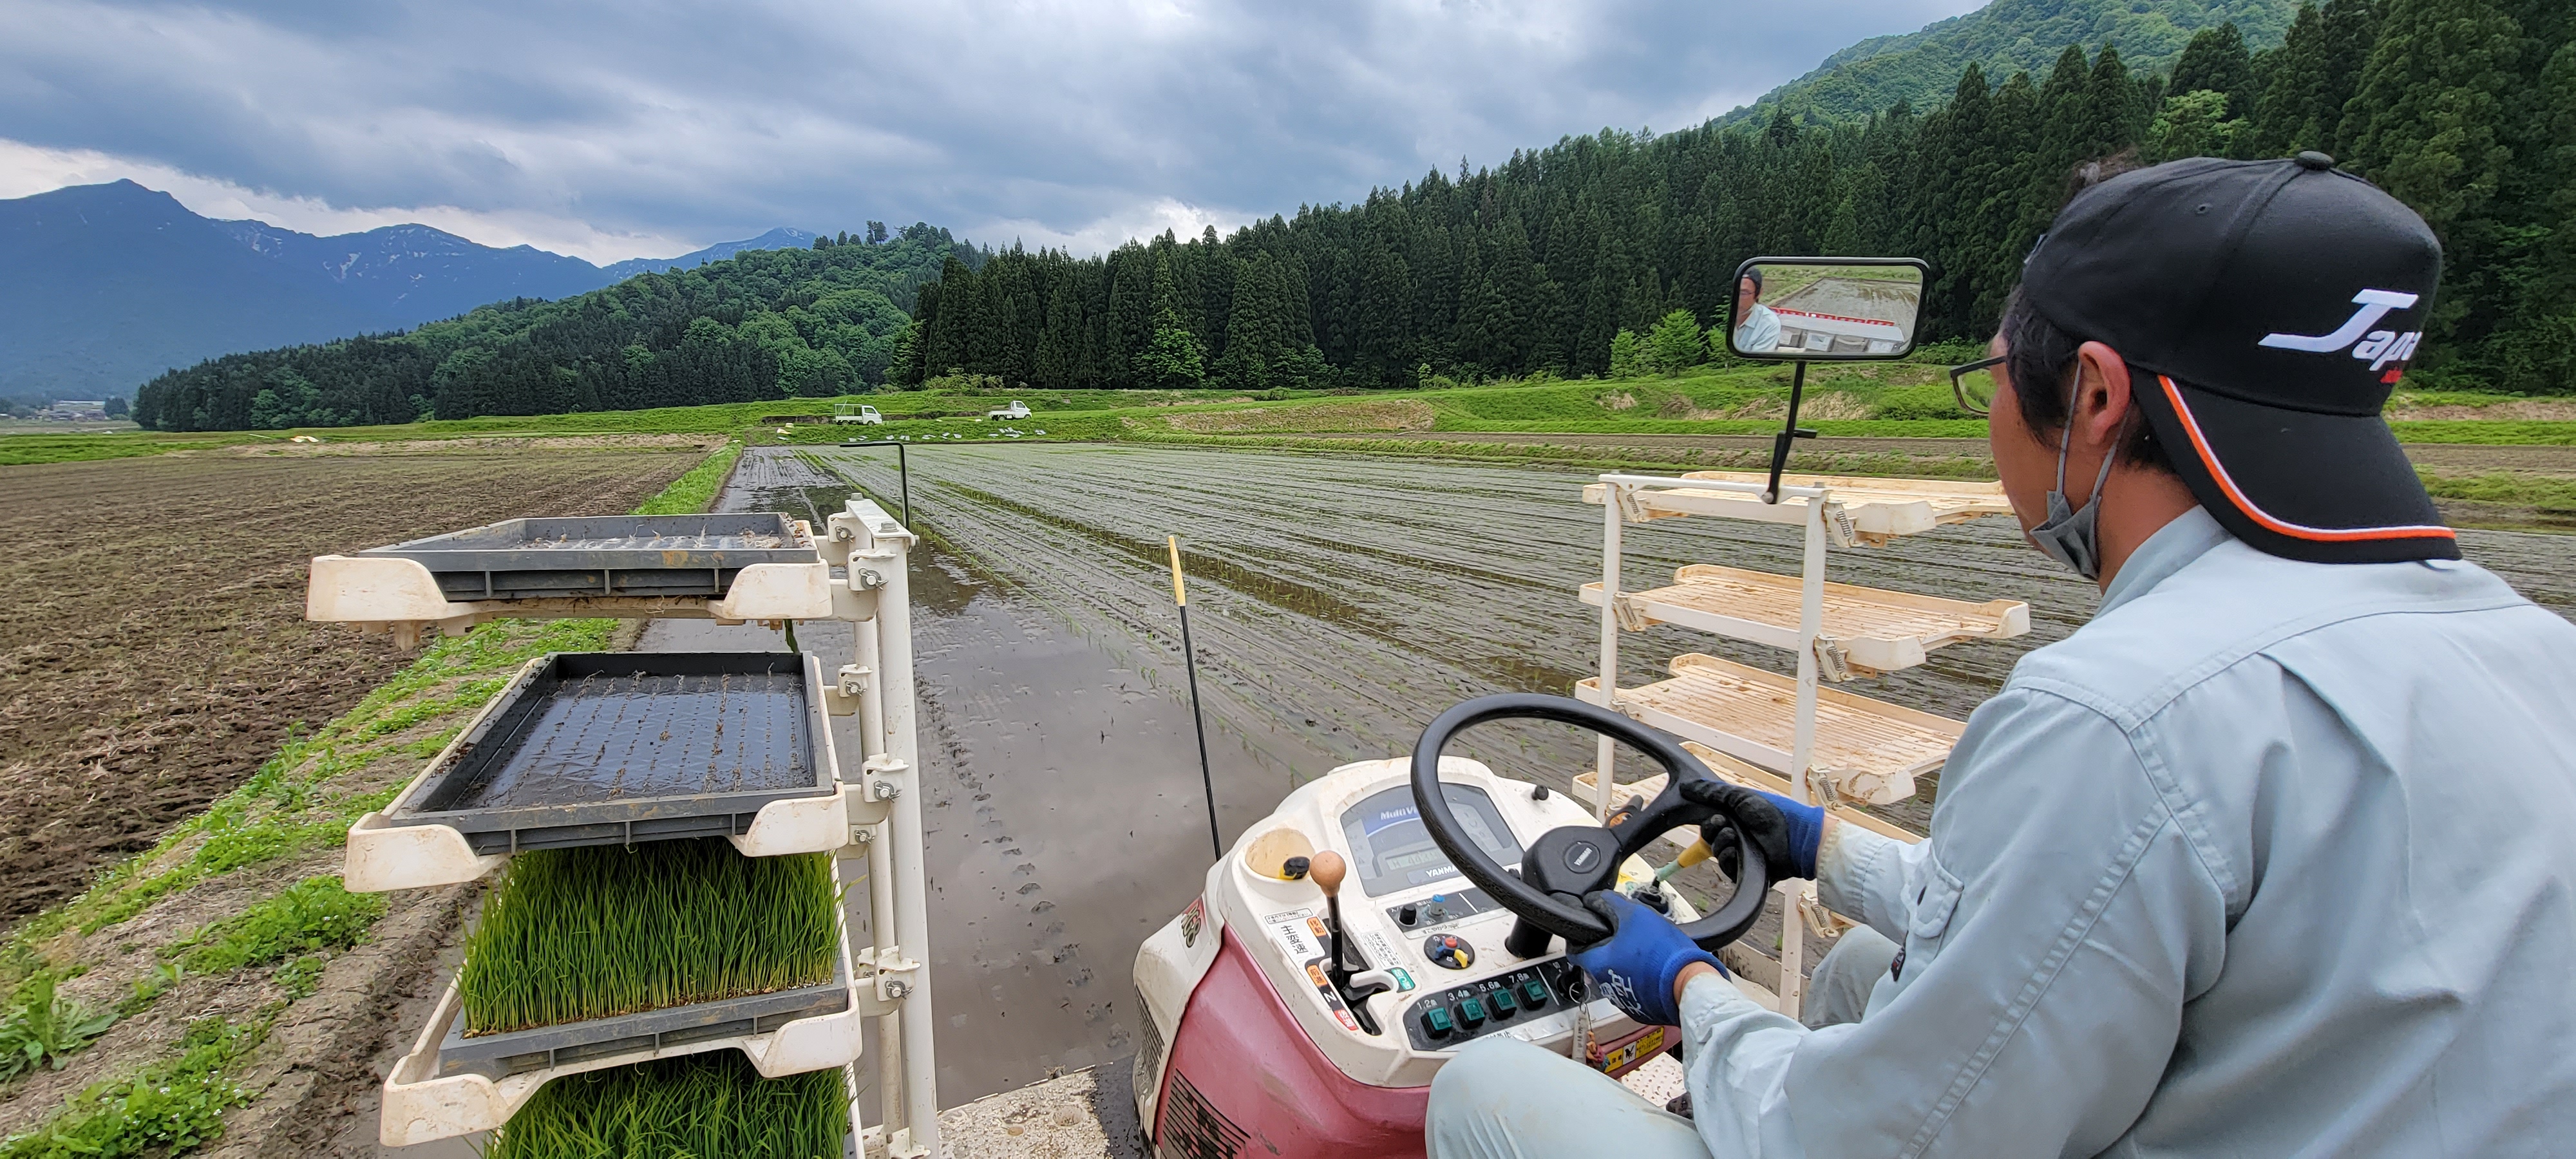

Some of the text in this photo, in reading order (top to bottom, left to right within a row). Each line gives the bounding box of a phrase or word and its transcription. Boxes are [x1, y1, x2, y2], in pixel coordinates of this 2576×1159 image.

[1426, 865, 1458, 878] YANMA
[1280, 925, 1309, 954] 主変速
[1323, 991, 1337, 1003] N
